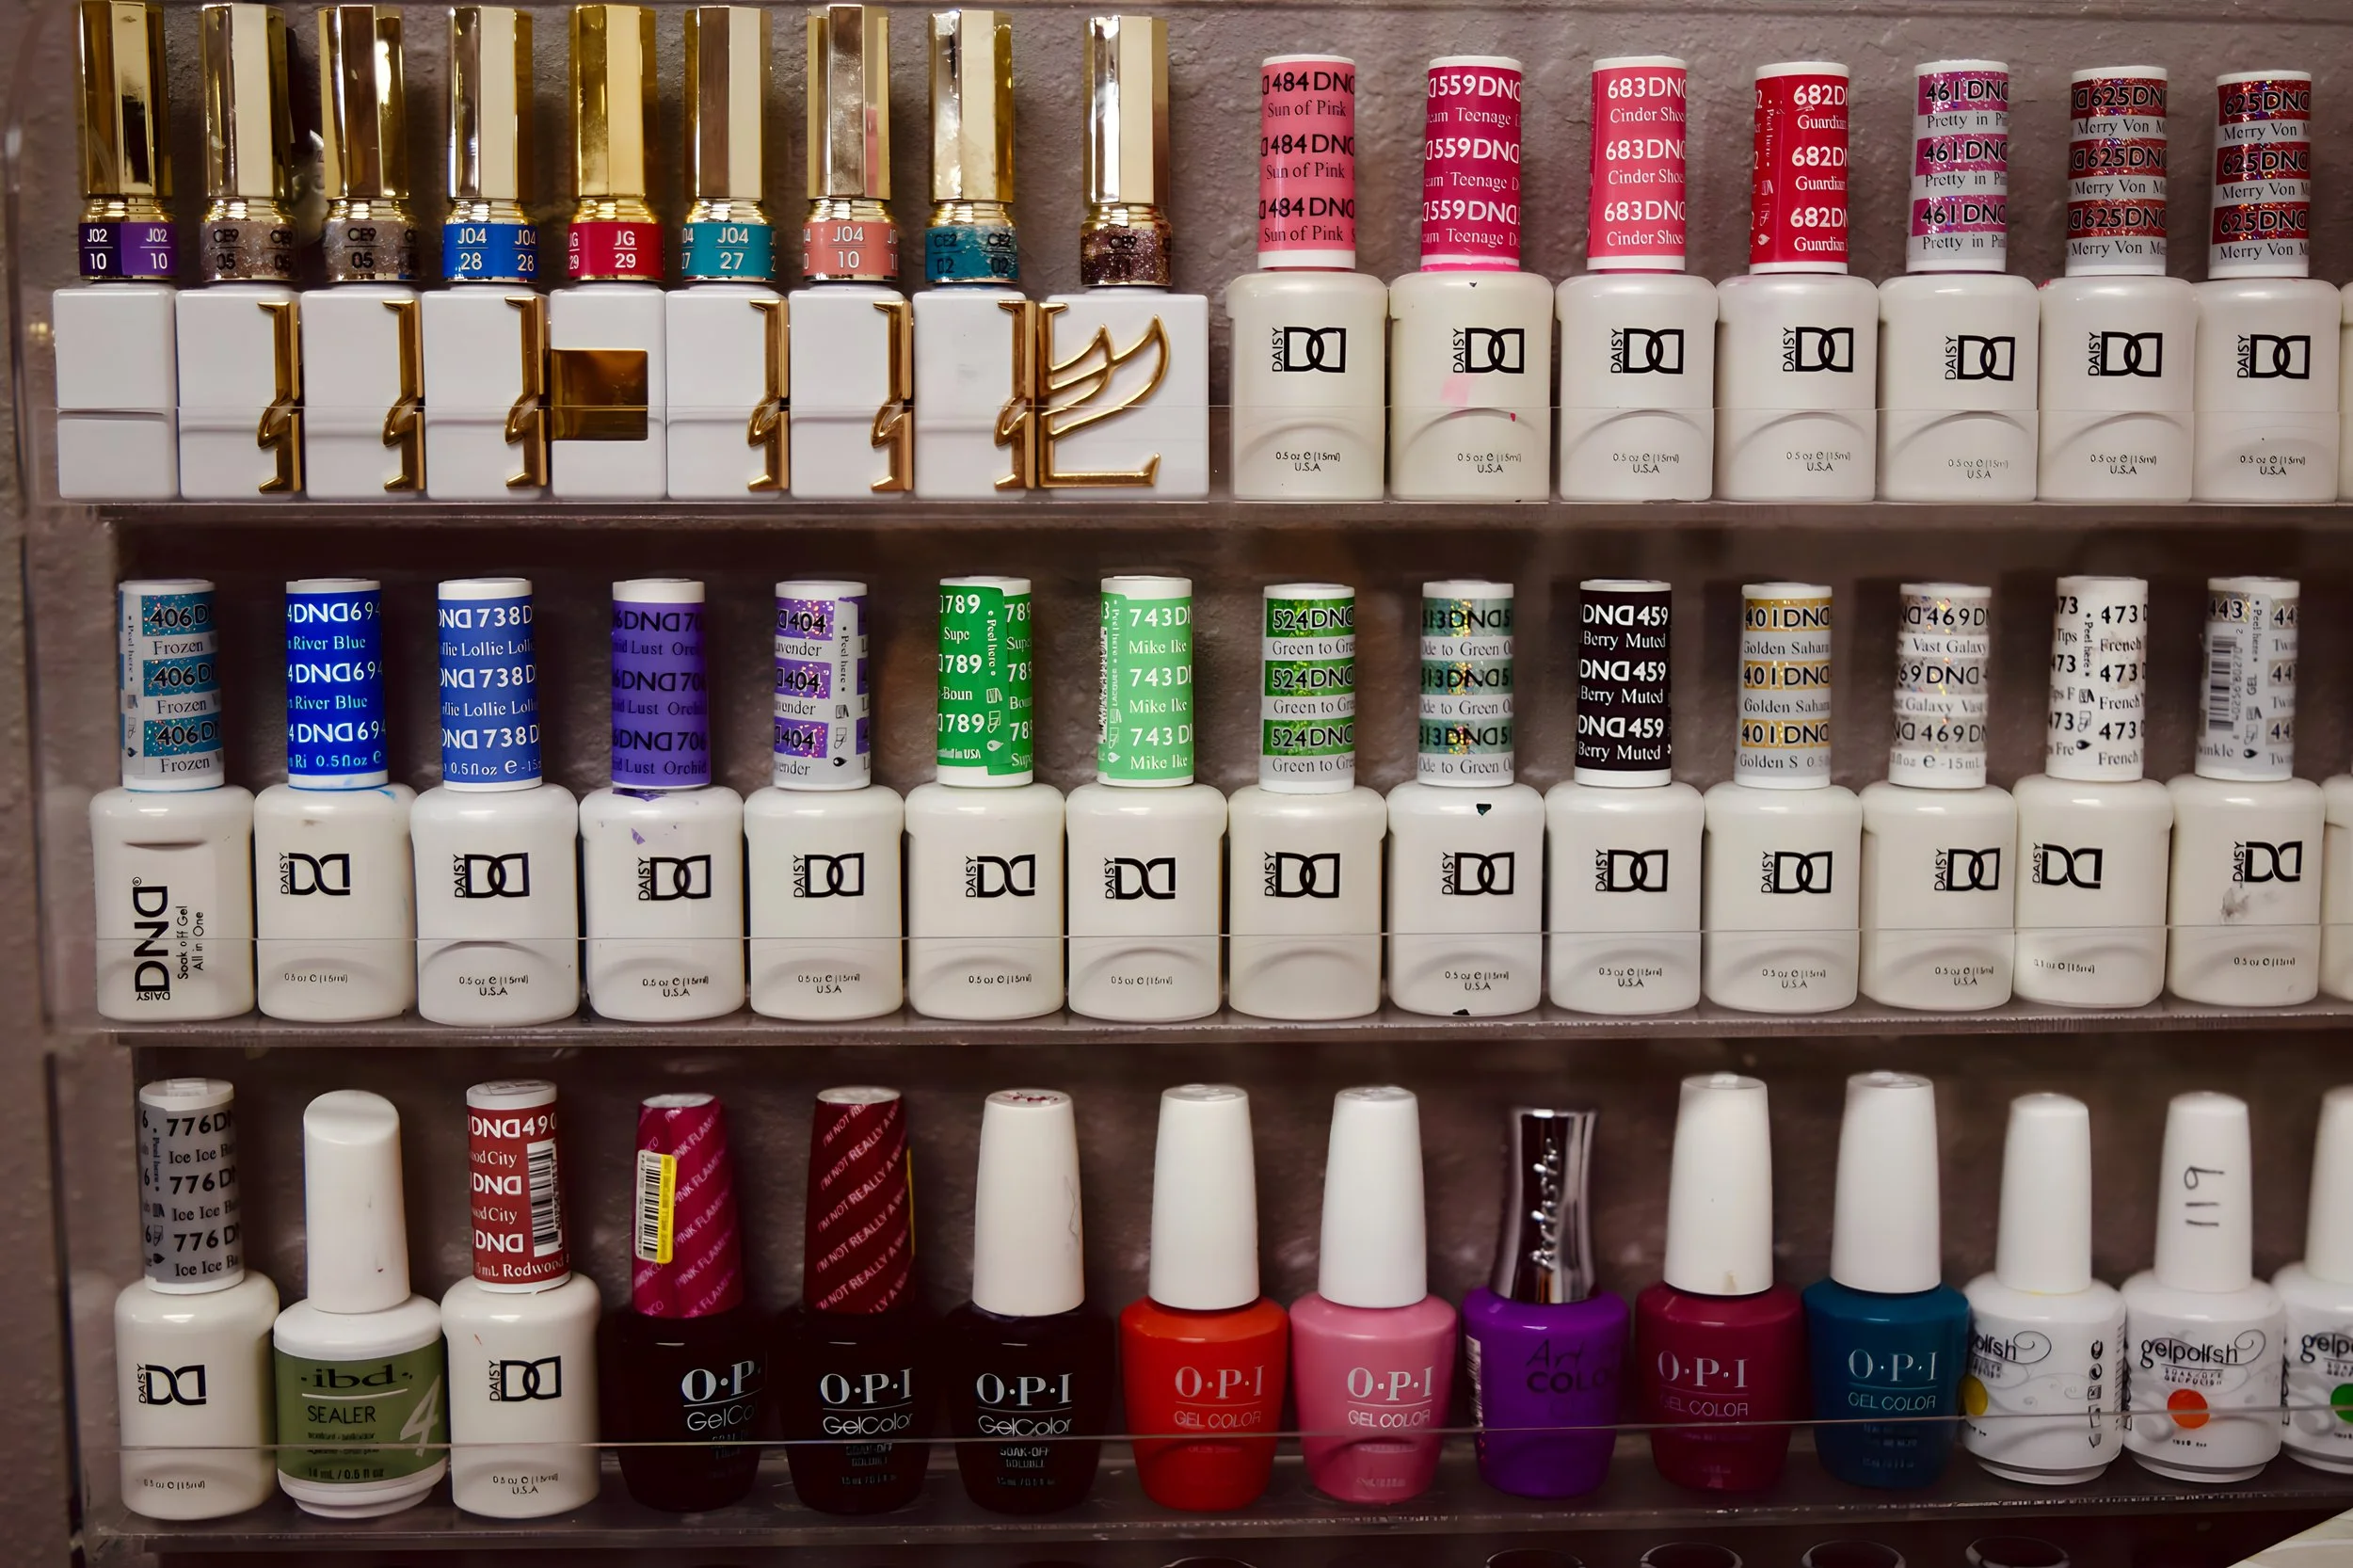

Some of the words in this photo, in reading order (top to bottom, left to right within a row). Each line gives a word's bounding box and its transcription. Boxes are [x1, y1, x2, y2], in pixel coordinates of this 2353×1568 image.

[1268, 102, 1290, 118] Sun
[1294, 99, 1309, 116] of
[1317, 99, 1347, 118] Pink
[1455, 106, 1512, 128] Teenage
[1610, 105, 1657, 123] Cinder
[1927, 113, 1969, 130] Pretty
[1976, 112, 1988, 126] in
[2077, 120, 2117, 136] Merry
[2122, 118, 2149, 133] Von
[2223, 126, 2265, 142] Merry
[2271, 122, 2297, 136] Von
[1266, 163, 1289, 180] Sun
[1292, 161, 1309, 178] of
[1315, 161, 1346, 179] Pink
[1925, 172, 1966, 189] Pretty
[2074, 180, 2114, 197] Merry
[87, 229, 108, 244] J02
[145, 229, 168, 244] J02
[348, 227, 377, 243] CE9
[457, 228, 487, 246] J04
[615, 231, 636, 247] JG
[717, 228, 749, 244] J04
[832, 226, 865, 243] J04
[89, 253, 107, 270] 10
[151, 253, 168, 270] 10
[351, 252, 375, 271] 05
[460, 252, 483, 271] 28
[615, 253, 636, 270] 29
[719, 252, 744, 270] 27
[838, 250, 859, 269] 10
[1272, 327, 1284, 373] DAISY
[1452, 328, 1465, 375] DAISY
[1610, 328, 1624, 375] DAISY
[1783, 327, 1796, 373] DAISY
[1945, 335, 1958, 381] DAISY
[2236, 333, 2250, 379] DAISY
[1129, 607, 1172, 629] 743
[1637, 605, 1669, 626] 459
[1927, 607, 1970, 626] 469
[2101, 605, 2138, 625] 473
[2253, 608, 2262, 632] Peel
[294, 636, 328, 650] River
[334, 635, 366, 650] Blue
[1583, 631, 1619, 650] Berry
[1625, 632, 1666, 648] Muted
[2084, 621, 2093, 645] Peel
[152, 640, 204, 656] Frozen
[461, 641, 504, 658] Lollie
[631, 641, 664, 656] Lust
[1129, 640, 1165, 655] Mike
[1273, 641, 1314, 656] Green
[1319, 640, 1333, 655] to
[1441, 643, 1453, 656] to
[1460, 641, 1499, 656] Green
[1913, 637, 1943, 653] Vast
[2100, 636, 2142, 652] French
[2247, 676, 2258, 696] GEL
[157, 698, 207, 715] Frozen
[296, 696, 329, 711] River
[1744, 697, 1790, 712] Golden
[454, 853, 467, 898] DAISY
[1104, 856, 1114, 900] DAISY
[1595, 848, 1608, 892] DAISY
[175, 905, 188, 926] Gel
[192, 910, 204, 937] One
[179, 929, 189, 948] off
[192, 942, 203, 953] in
[177, 951, 189, 981] Soak
[191, 954, 204, 971] All
[136, 990, 171, 1001] DAISY
[167, 1114, 212, 1137] 776
[169, 1150, 191, 1165] Ice
[196, 1147, 216, 1163] Ice
[488, 1150, 518, 1169] City
[829, 1199, 849, 1220] NOT
[848, 1166, 886, 1205] REALLY
[886, 1159, 894, 1172] A
[199, 1205, 220, 1220] Ice
[2140, 1338, 2238, 1368] gelpolish
[312, 1363, 397, 1389] ibd
[1527, 1368, 1609, 1394] COLO
[1689, 1400, 1749, 1417] COLOR
[1848, 1391, 1879, 1410] GEL
[1881, 1394, 1936, 1412] COLOR
[307, 1405, 376, 1424] SEALER
[399, 1373, 440, 1458] 4
[686, 1404, 755, 1432] GelCo
[823, 1413, 914, 1435] GelColor
[1174, 1410, 1206, 1427] GEL
[1209, 1410, 1261, 1429] COLOR
[1348, 1409, 1377, 1428] GEL
[1380, 1408, 1431, 1429] COLOR
[978, 1415, 1073, 1436] GelColor
